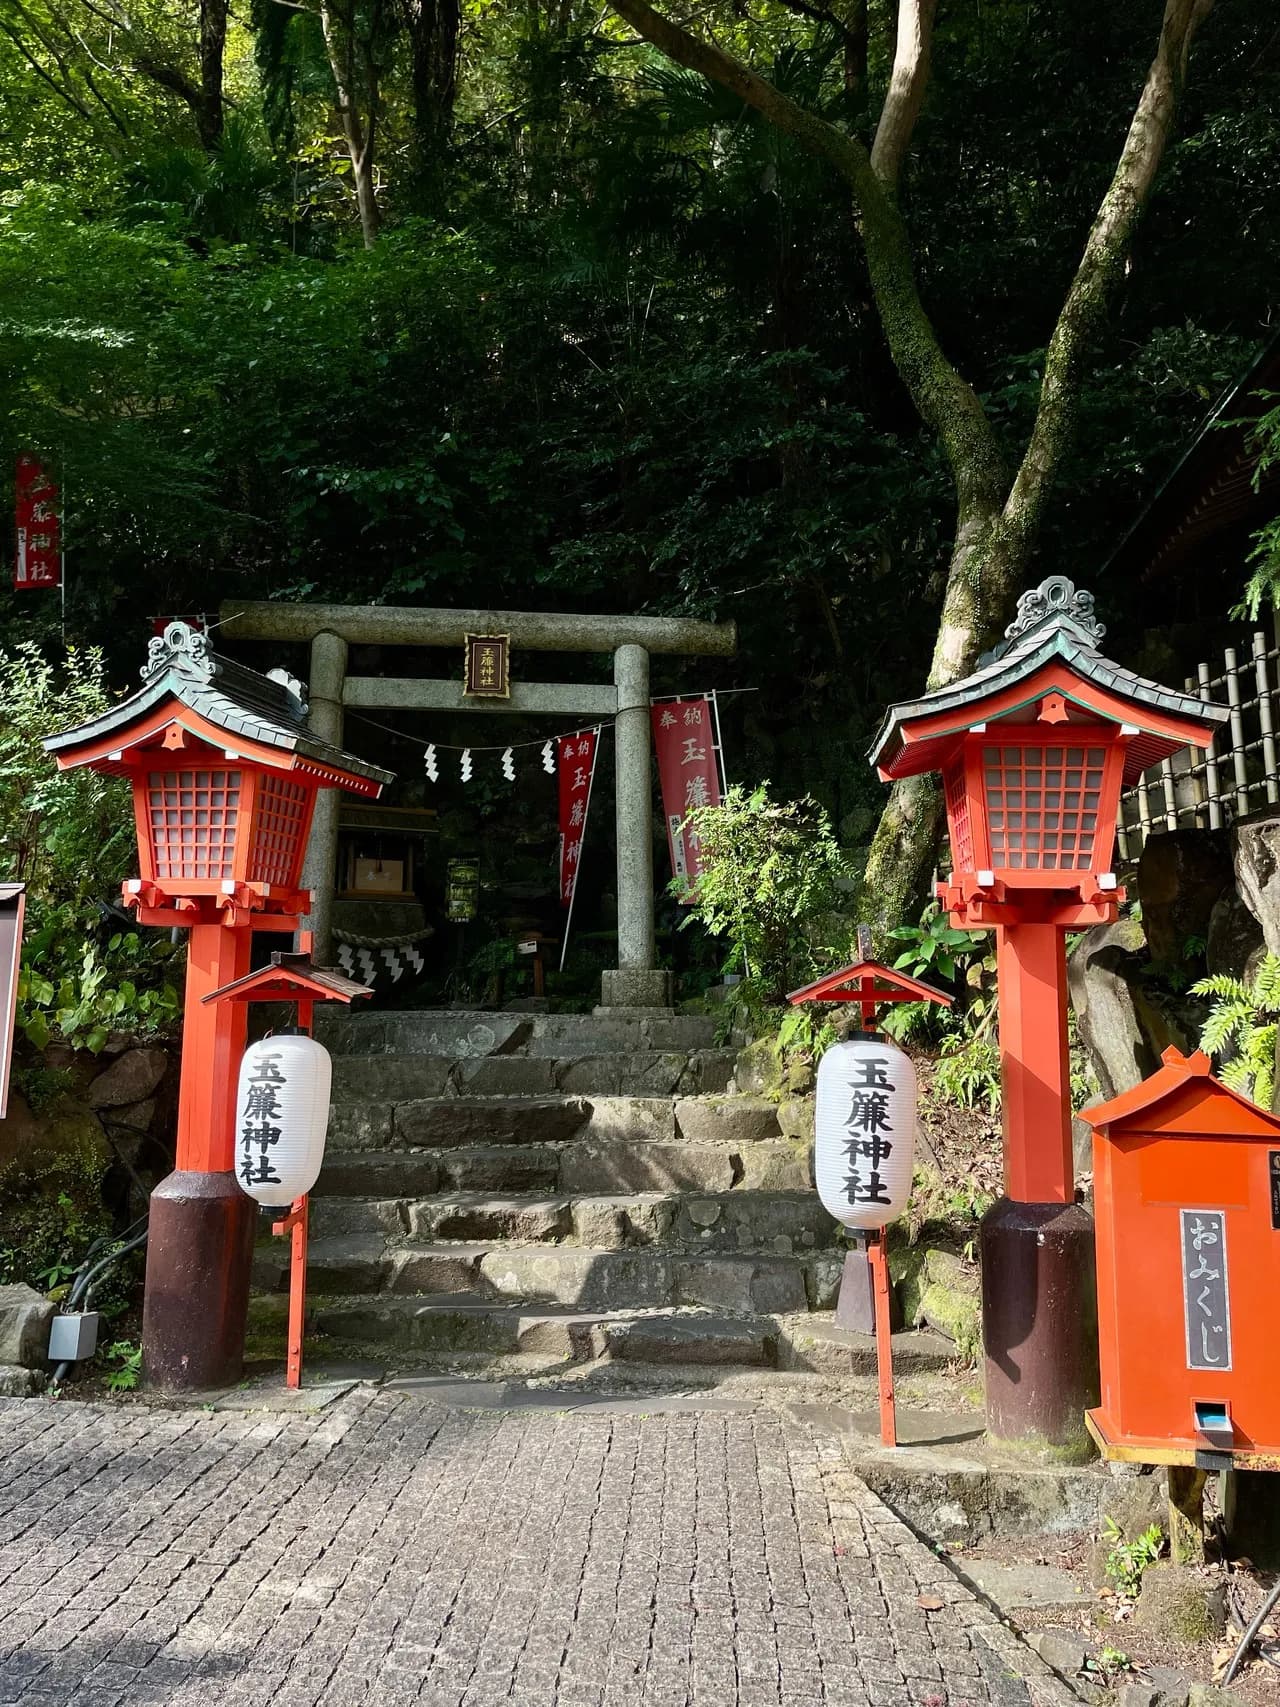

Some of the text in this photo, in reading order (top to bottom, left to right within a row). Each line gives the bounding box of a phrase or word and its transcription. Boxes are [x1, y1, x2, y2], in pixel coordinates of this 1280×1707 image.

[563, 739, 590, 761] 奉納
[659, 707, 702, 730] 奉納
[240, 1053, 287, 1187] 玉簾神社
[840, 1058, 896, 1206] 玉簾神社
[1189, 1217, 1223, 1363] おみくじ
